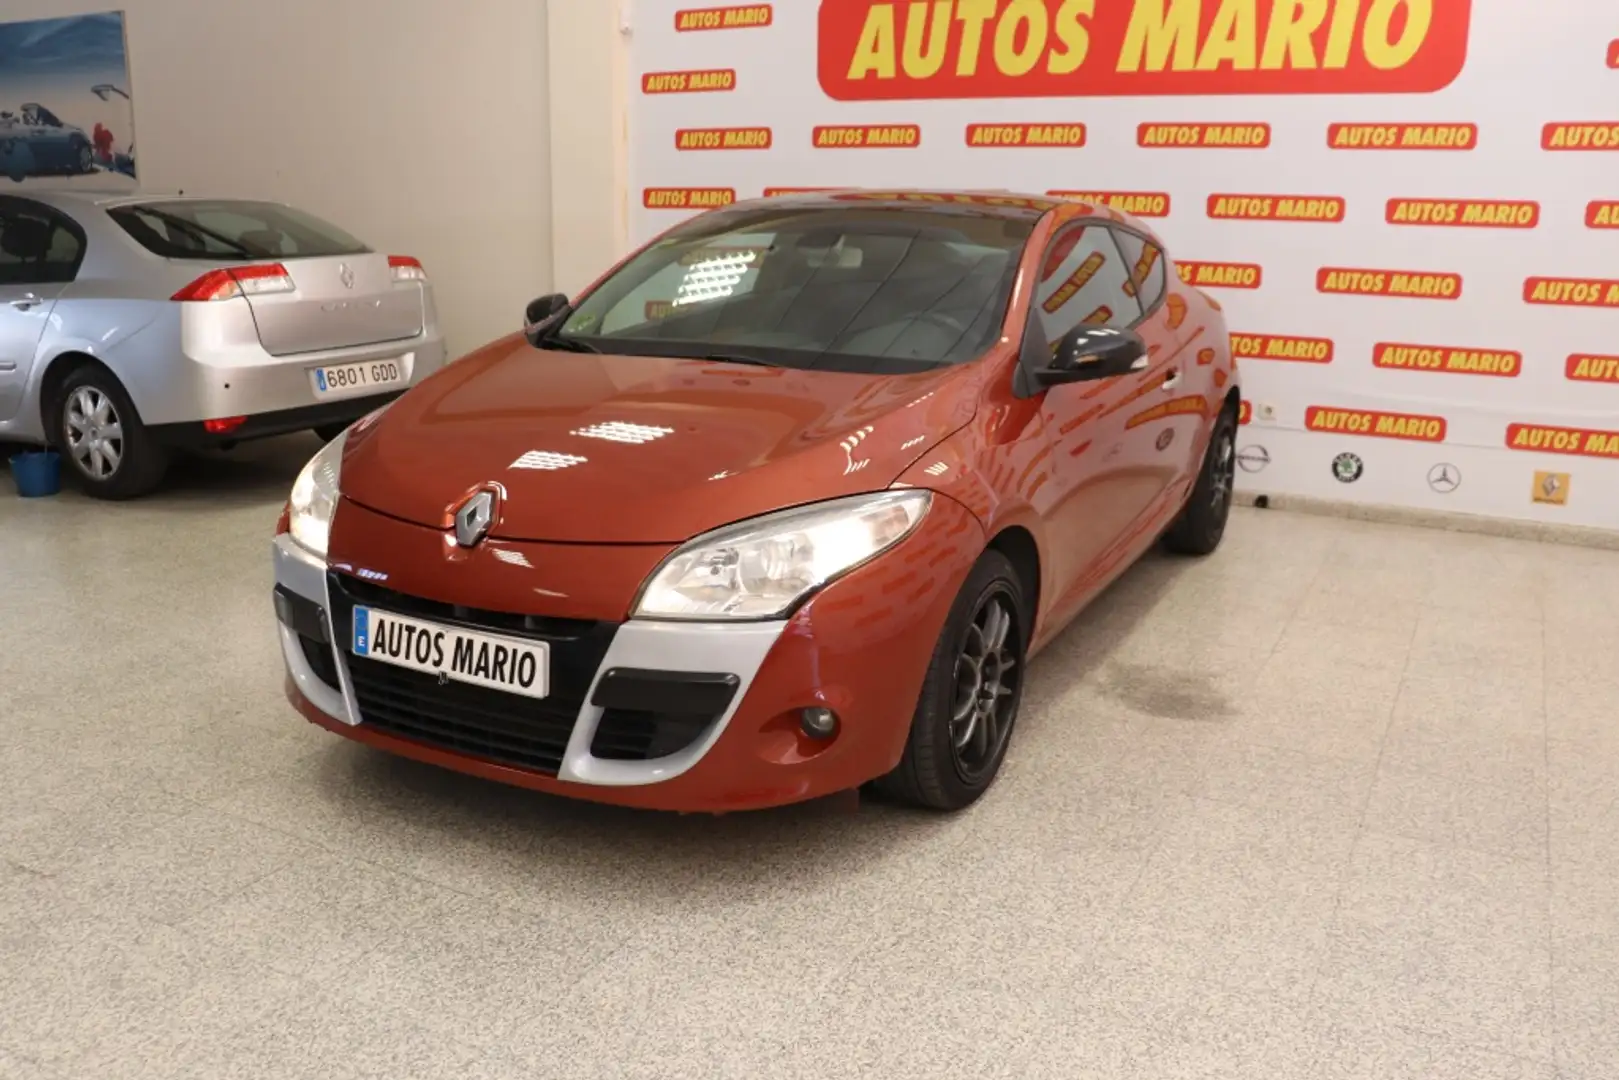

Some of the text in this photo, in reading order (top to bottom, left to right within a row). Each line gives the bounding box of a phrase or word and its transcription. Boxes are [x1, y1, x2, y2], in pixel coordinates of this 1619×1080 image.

[679, 8, 769, 28] AUTOS MARIO
[847, 0, 1434, 79] AUTOS MARIO
[647, 71, 732, 91] AUTOS MARIO
[681, 130, 768, 148] AUTOS MARIO
[818, 127, 916, 145] AUTOS MARIO
[972, 126, 1081, 144] AUTOS MARIO
[1143, 125, 1266, 145] AUTOS MARIO
[1335, 126, 1472, 147] AUTOS MARIO
[647, 190, 732, 206] AUTOS MARIO
[1108, 195, 1165, 213] MARIO
[1214, 197, 1340, 219] AUTOS MARIO
[1392, 202, 1534, 225] AUTOS MARIO
[1196, 265, 1257, 285] MARIO
[1323, 271, 1457, 296] AUTOS MARIO
[1531, 280, 1601, 303] AUTOS
[1266, 338, 1329, 360] MARIO
[1379, 346, 1516, 373] AUTOS MARIO
[327, 363, 398, 388] 6801 GDD
[1312, 410, 1441, 439] AUTOS MARIO
[1513, 428, 1581, 450] AUTOS
[372, 618, 446, 668] AUTOS
[451, 635, 537, 689] MARIO
